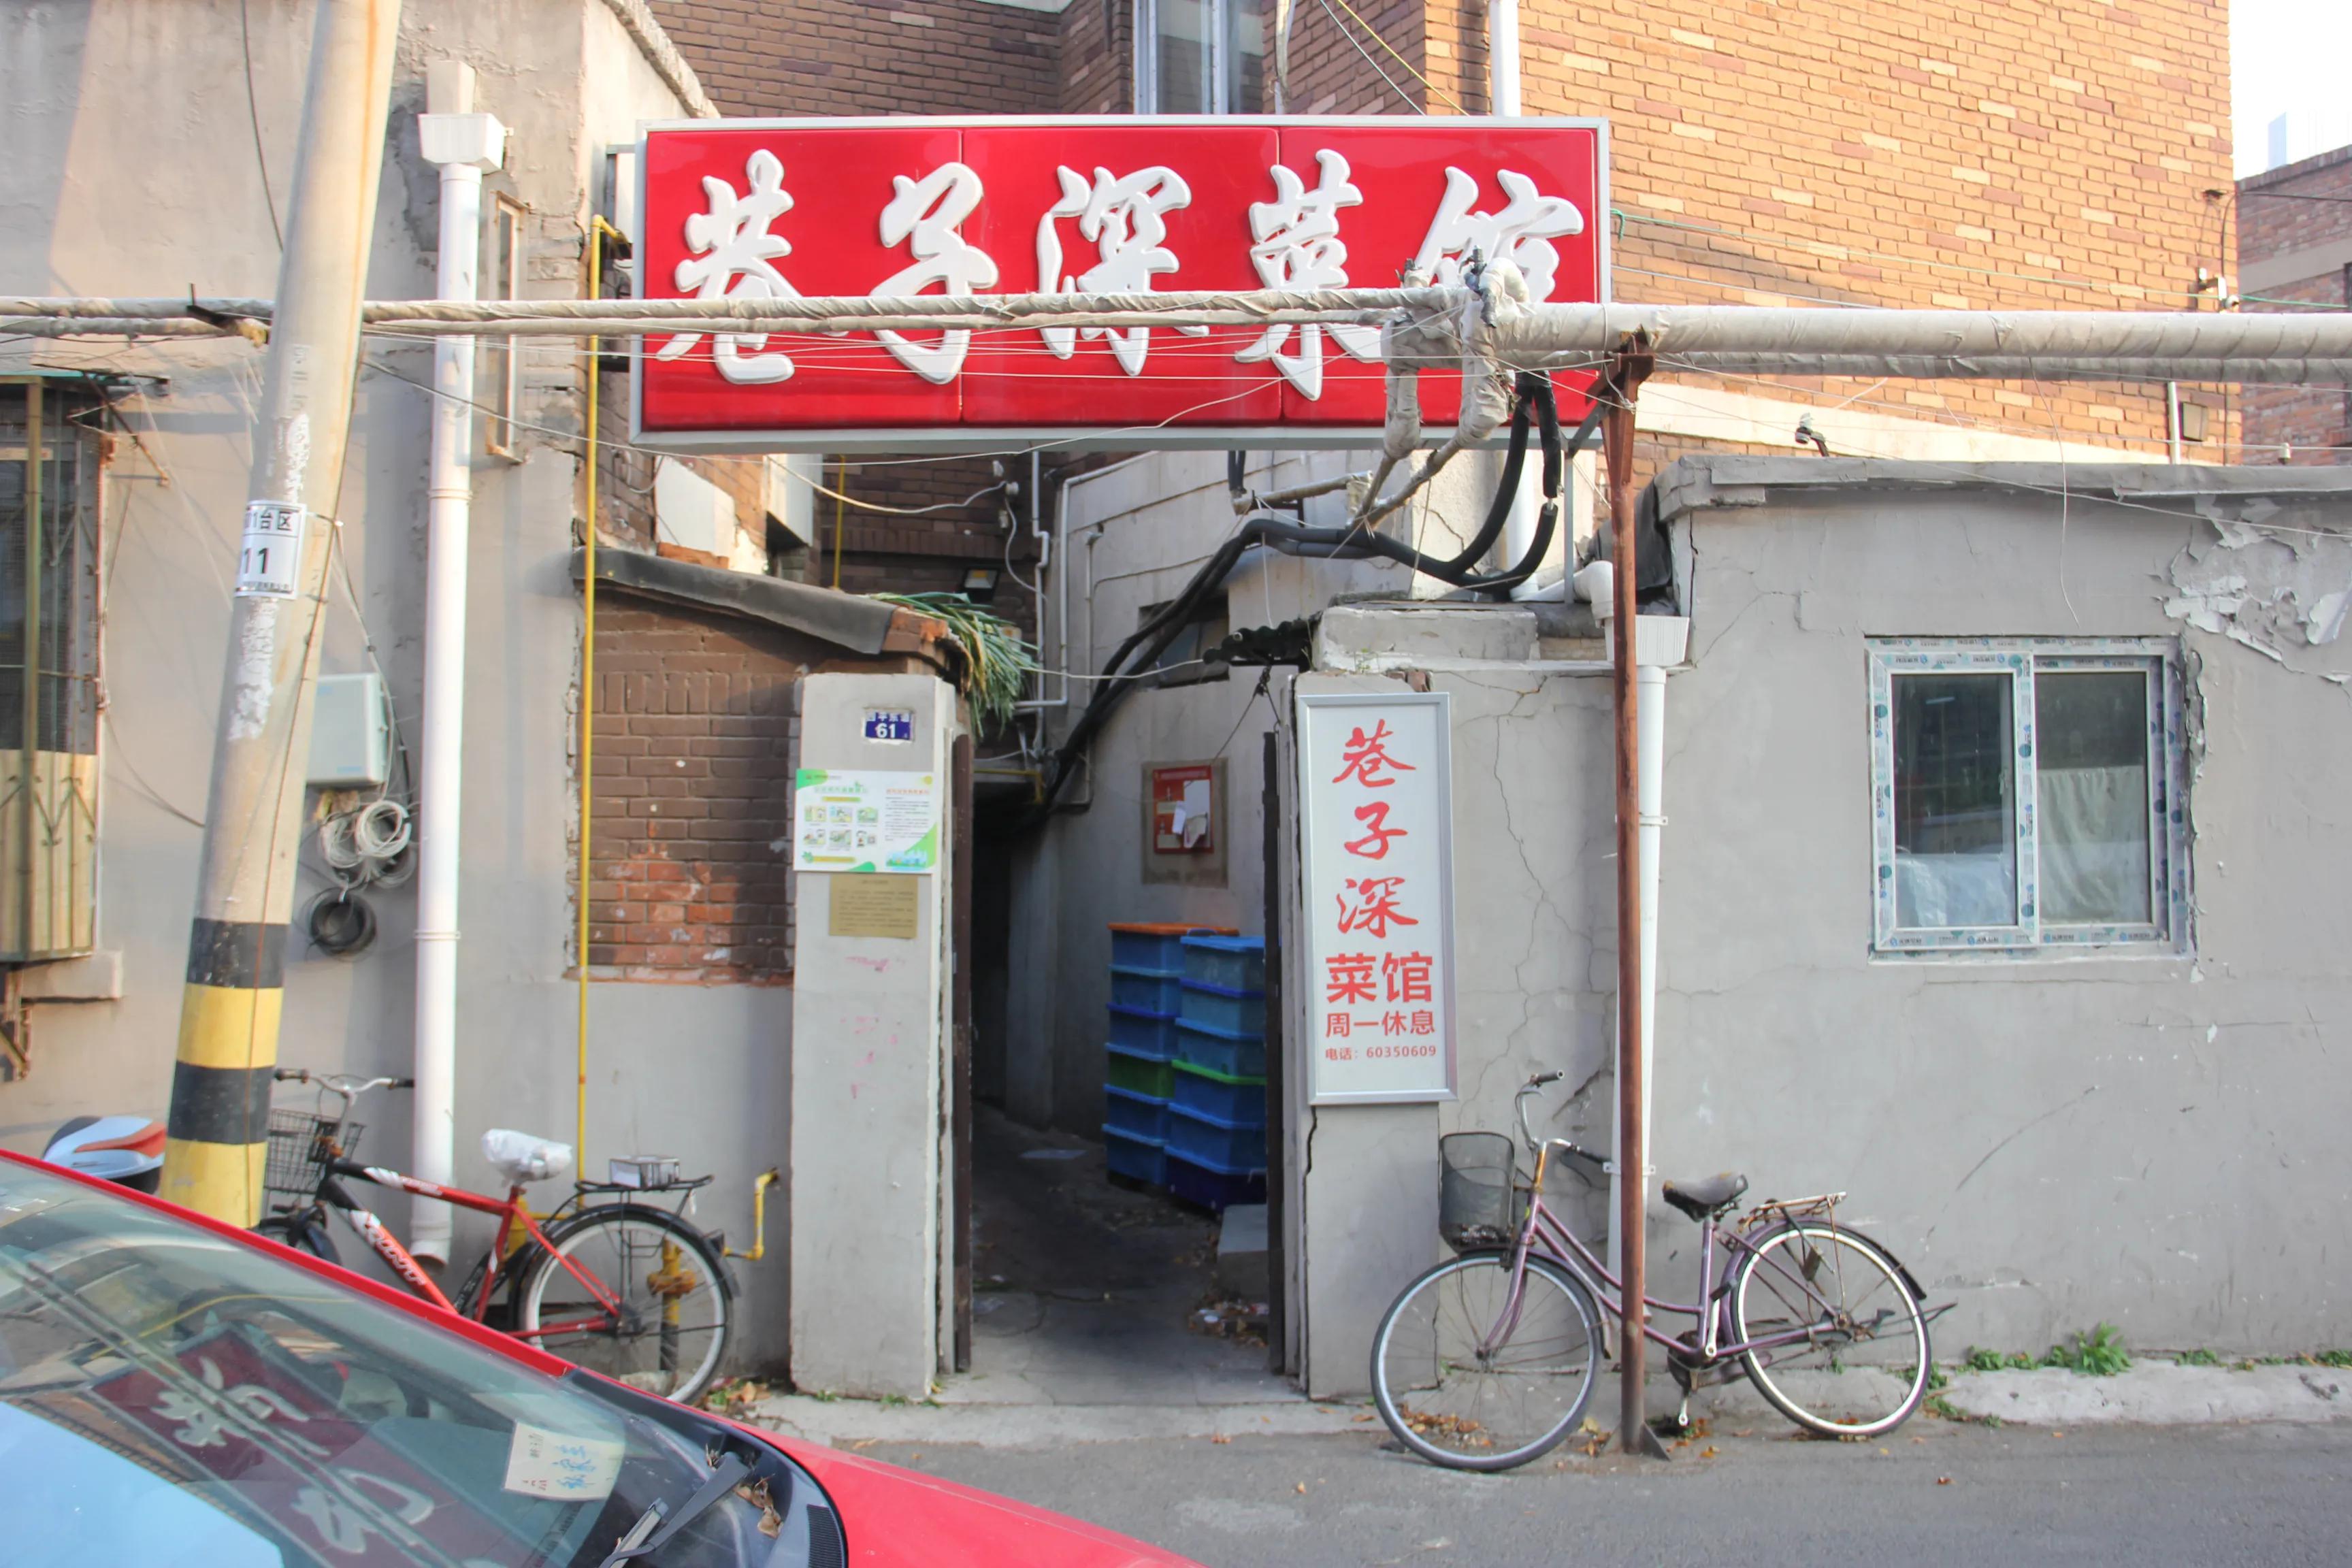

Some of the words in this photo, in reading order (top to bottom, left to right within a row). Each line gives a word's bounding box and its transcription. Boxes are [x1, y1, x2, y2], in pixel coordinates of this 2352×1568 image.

[875, 722, 896, 738] 61
[1332, 719, 1419, 938] 巷子深
[1325, 951, 1433, 1004] 菜馆
[1325, 1009, 1435, 1038] 周一休息
